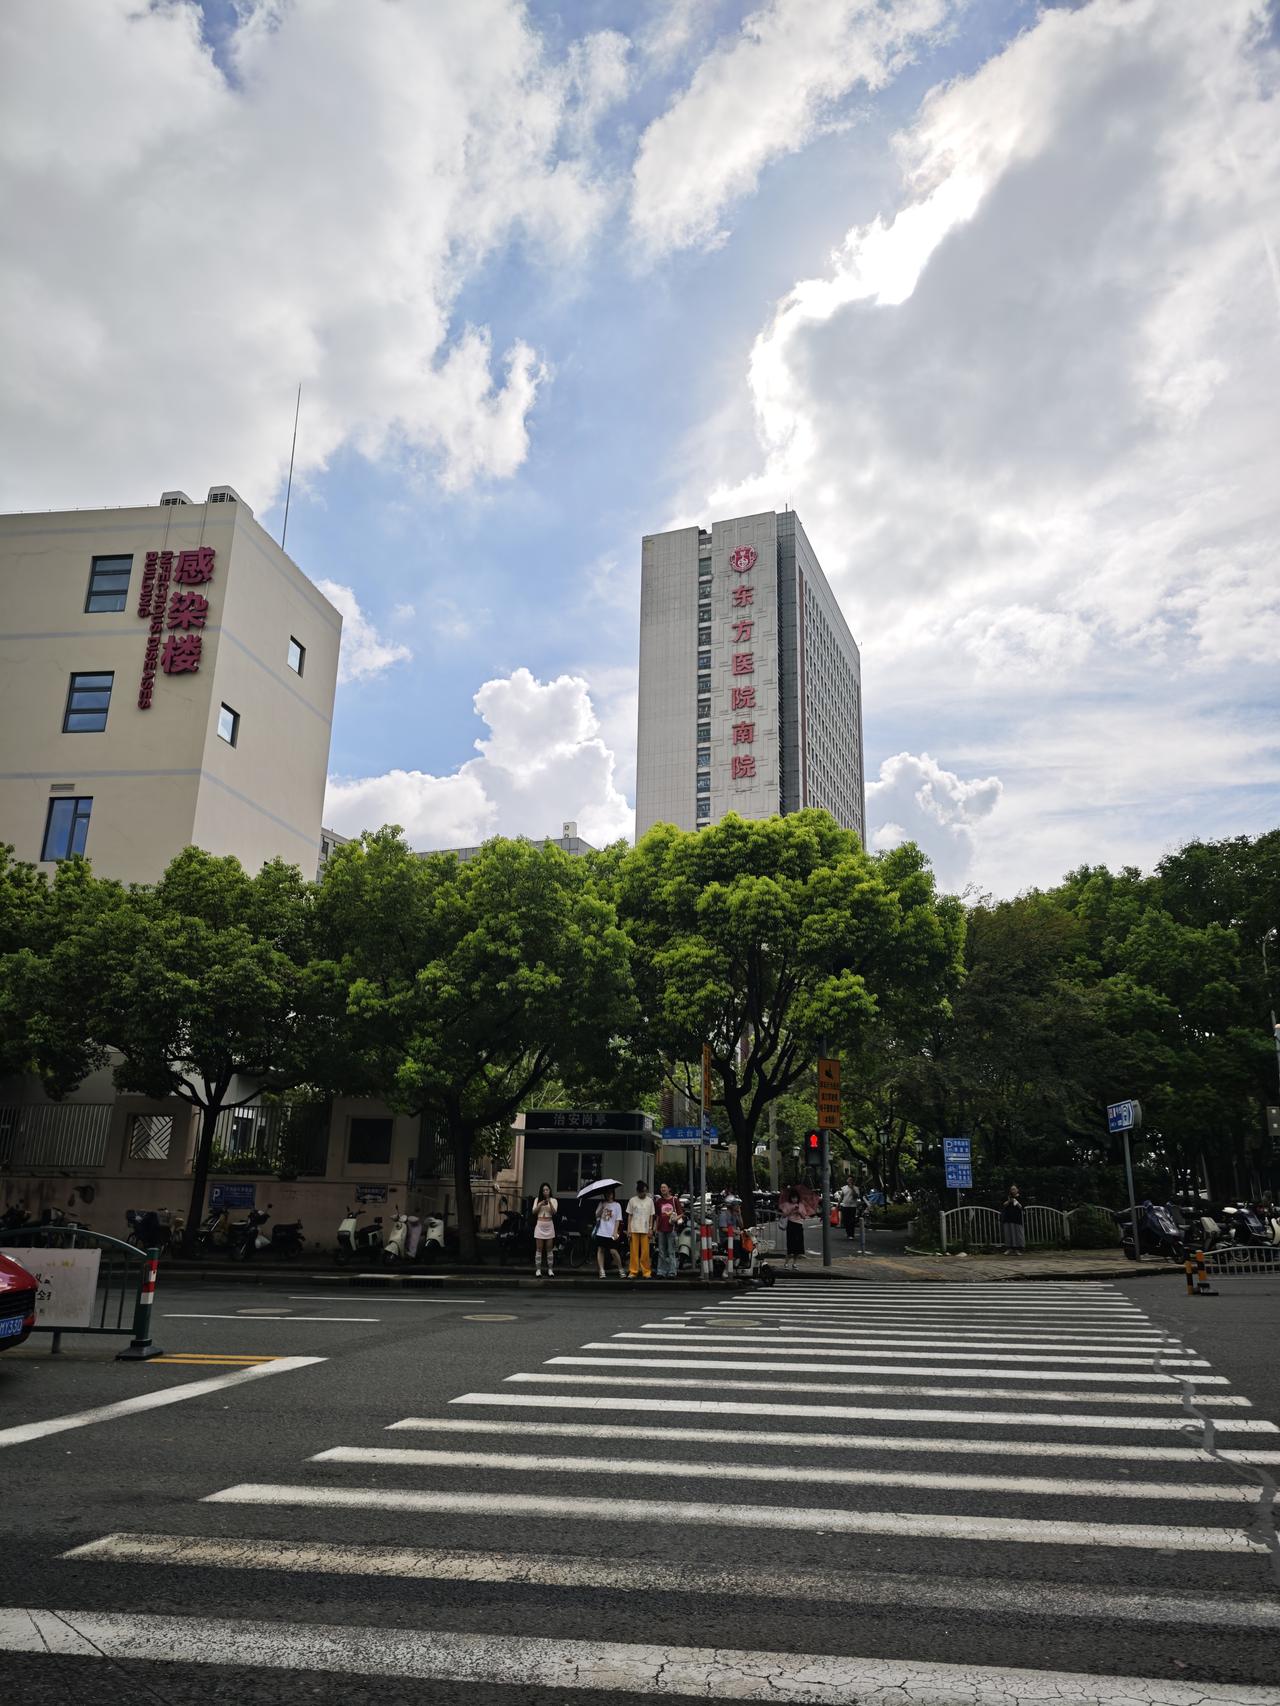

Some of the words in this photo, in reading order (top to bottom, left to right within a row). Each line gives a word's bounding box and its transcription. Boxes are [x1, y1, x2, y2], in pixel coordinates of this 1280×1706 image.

[137, 551, 158, 618] BUILDING
[151, 551, 173, 634] INFECTIOUS
[161, 547, 215, 674] 感染楼
[138, 637, 160, 709] DISEASES
[731, 585, 756, 780] 东方医院南院
[553, 1113, 608, 1126] 治安岗亭
